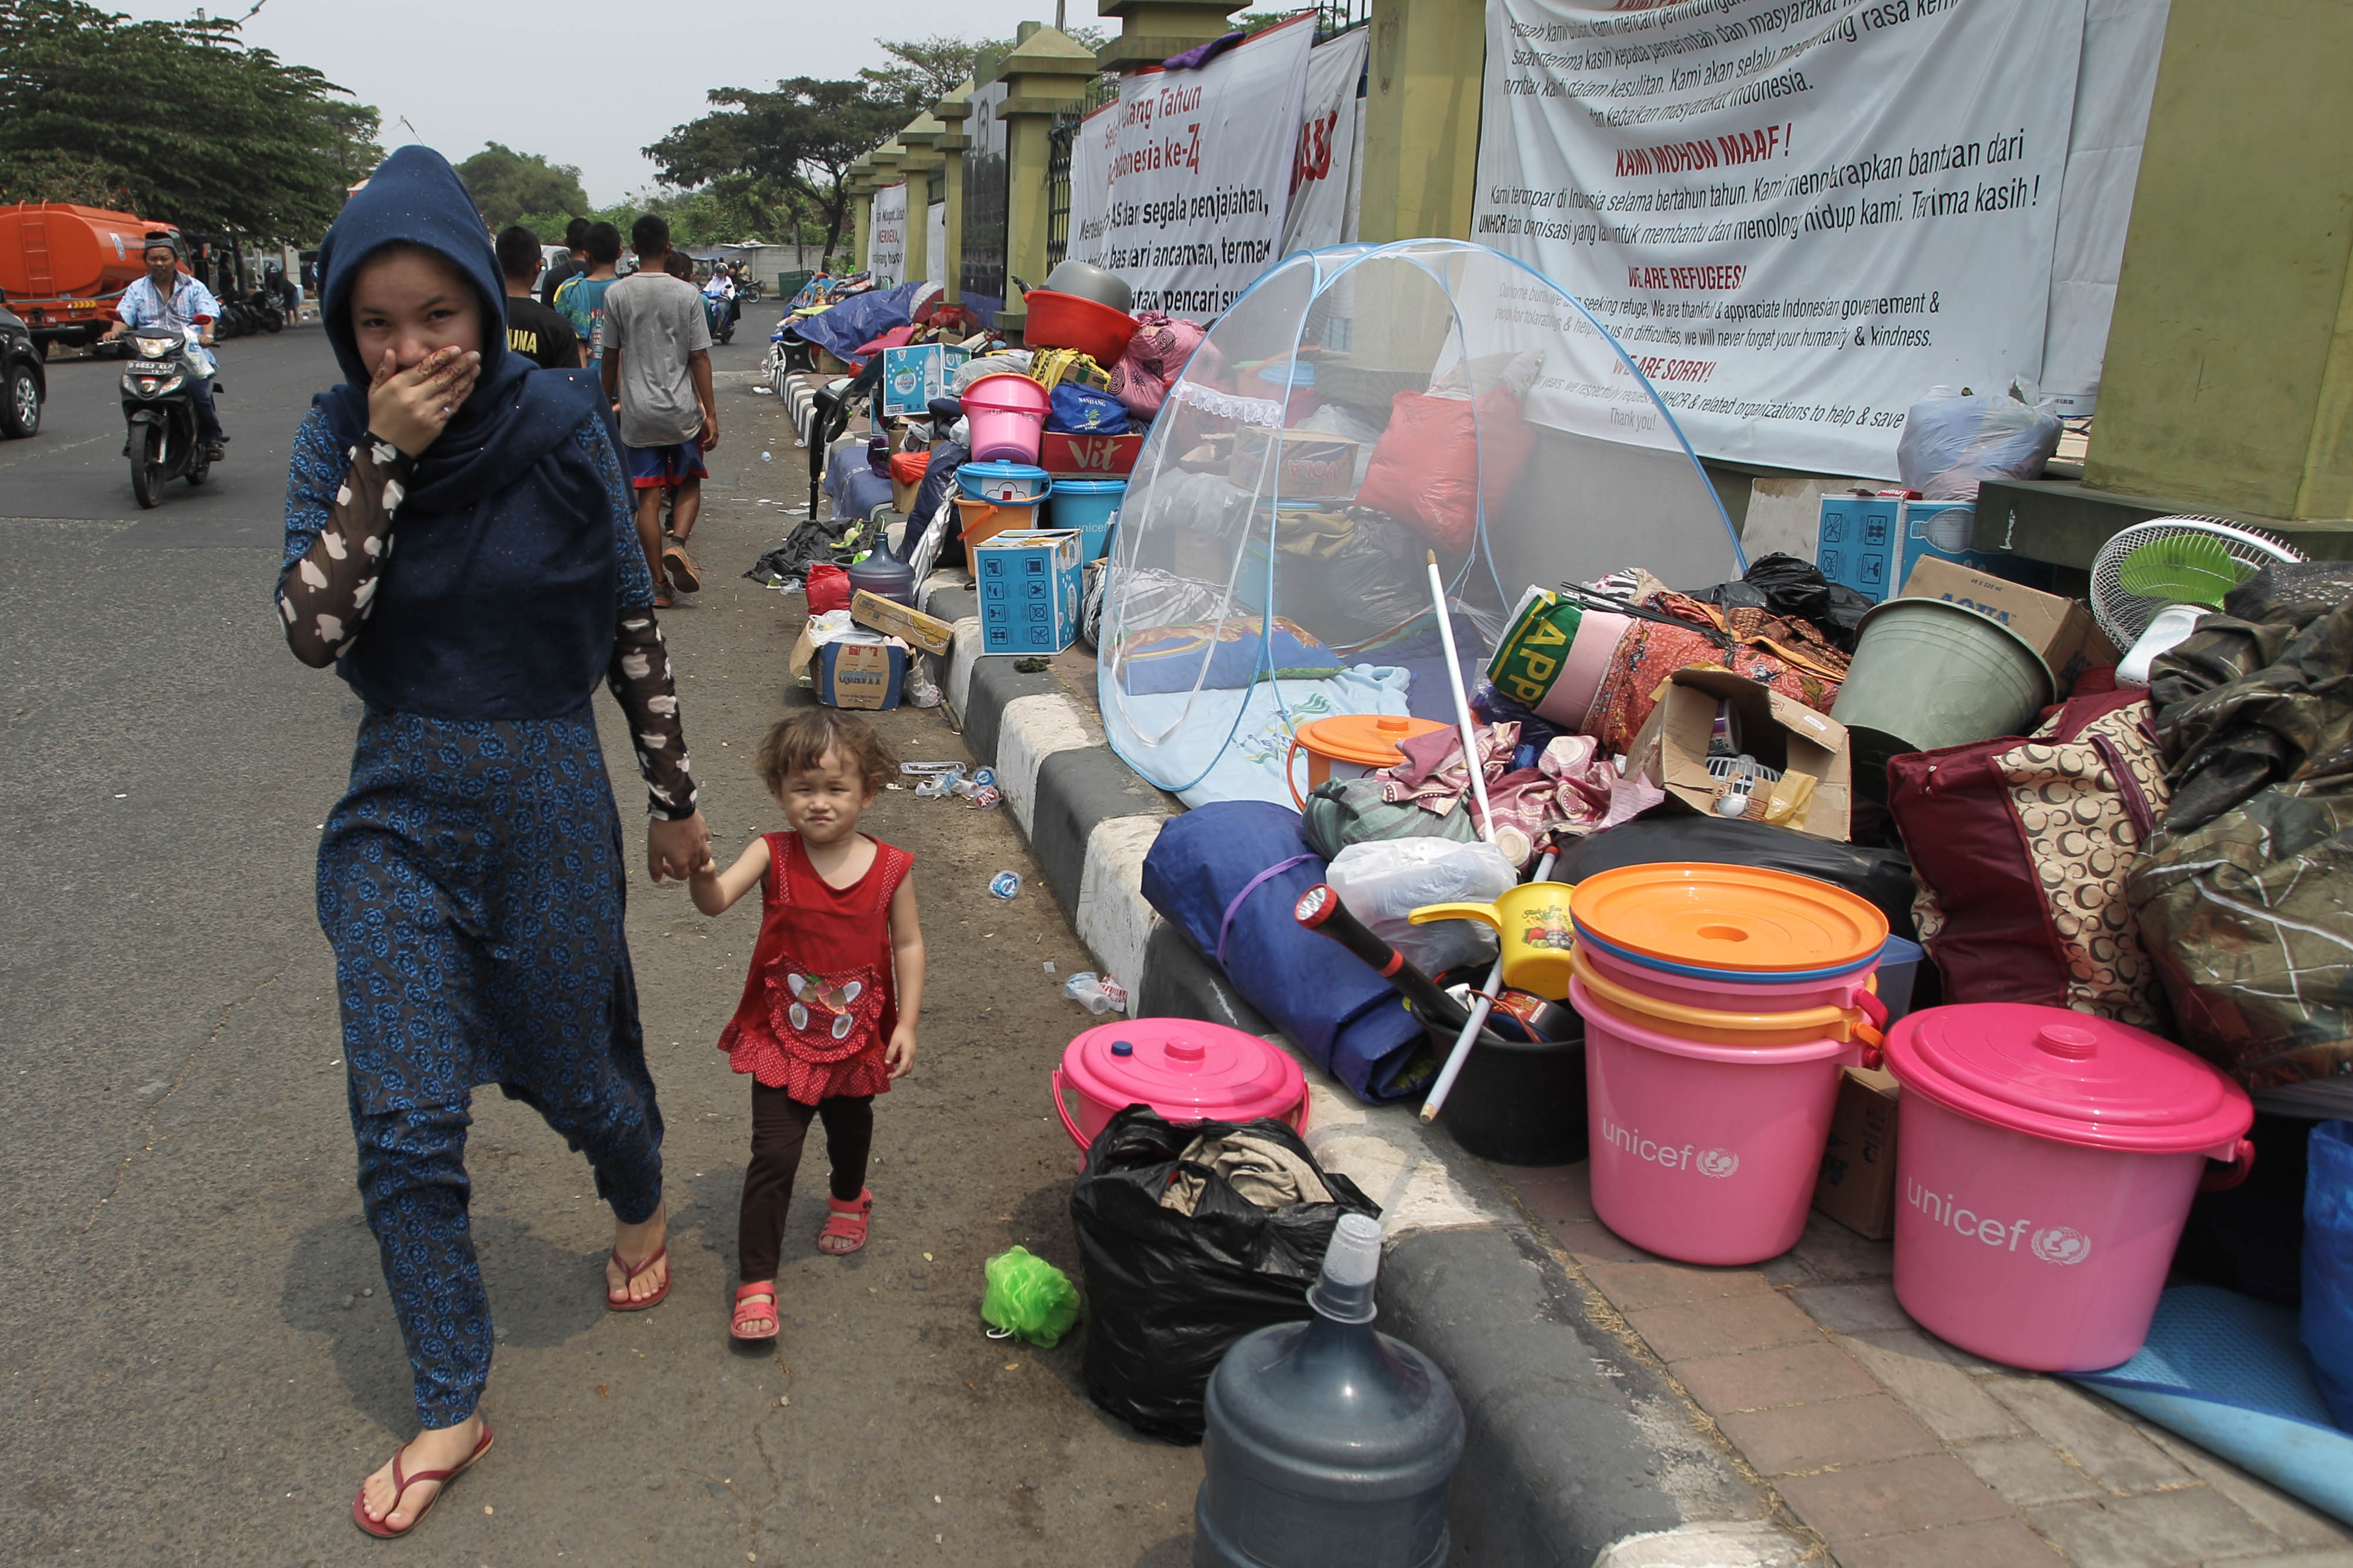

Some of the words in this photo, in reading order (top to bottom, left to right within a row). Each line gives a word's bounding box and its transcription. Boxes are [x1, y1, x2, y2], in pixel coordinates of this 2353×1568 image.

[1614, 11, 1656, 34] mencari
[1568, 80, 1608, 98] dalam
[1606, 74, 1664, 98] kesulitan.
[1669, 64, 1701, 92] Kami
[1704, 61, 1734, 86] akan
[1736, 46, 1775, 79] selalu
[1861, 0, 1911, 31] rasa
[1585, 46, 1612, 70] kasih
[1614, 43, 1648, 69] kepada
[1648, 29, 1718, 64] pemerintah
[1716, 24, 1748, 43] dan
[1159, 84, 1202, 118] Tahun
[1607, 105, 1659, 128] kebaikan
[1615, 148, 1652, 176] KAMI
[1649, 138, 1718, 175] MOHON
[1720, 125, 1779, 166] MAAF
[1491, 185, 1511, 204] Kami
[1557, 188, 1567, 208] di
[1607, 191, 1652, 212] selama
[1655, 186, 1706, 211] bertahun
[1710, 182, 1747, 207] tahun.
[1752, 174, 1788, 202] Kami
[1987, 128, 2024, 164] dari
[1142, 193, 1186, 229] segala
[1189, 183, 1268, 227] penjajahan,
[1479, 214, 1507, 233] UNHCR
[1508, 215, 1522, 234] dan
[1572, 223, 1596, 246] yang
[1641, 222, 1709, 244] membantu
[1708, 219, 1732, 242] dan
[1805, 203, 1855, 233] hidup
[1859, 192, 1904, 226] kami.
[1974, 178, 2026, 214] kasih
[1153, 243, 1217, 270] ancaman,
[1628, 266, 1642, 289] WE
[1644, 266, 1669, 289] ARE
[1670, 265, 1747, 291] REFUGEES!
[1164, 283, 1218, 316] pencari
[1584, 296, 1618, 316] seeking
[1619, 297, 1649, 319] refuge,
[1651, 299, 1665, 317] We
[1666, 302, 1679, 318] are
[1681, 300, 1716, 319] thankful
[1724, 299, 1780, 323] appraciate
[1782, 297, 1839, 318] Indonesian
[1929, 291, 1939, 313] &
[1611, 325, 1621, 338] us
[1622, 323, 1633, 339] in
[1634, 324, 1681, 346] difficulties,
[1685, 331, 1697, 345] we
[1699, 328, 1714, 346] will
[1718, 331, 1745, 346] never
[1745, 328, 1775, 351] forget
[1774, 331, 1800, 351] your
[1800, 328, 1849, 349] humanity
[1854, 327, 1865, 346] &
[1871, 325, 1932, 347] kindness.
[1638, 357, 1665, 379] ARE
[1661, 359, 1716, 383] SORRY!
[1610, 408, 1634, 427] Thank
[1637, 413, 1657, 432] you!
[1688, 395, 1701, 410] &
[1698, 396, 1737, 415] related
[1734, 400, 1810, 420] organizations
[1810, 404, 1825, 422] to
[1826, 405, 1855, 427] help
[1856, 406, 1870, 425] &
[1870, 412, 1905, 429] save
[1068, 436, 1122, 471] Vit
[1602, 1117, 1695, 1170] unicef
[1908, 1176, 2031, 1252] unicef
